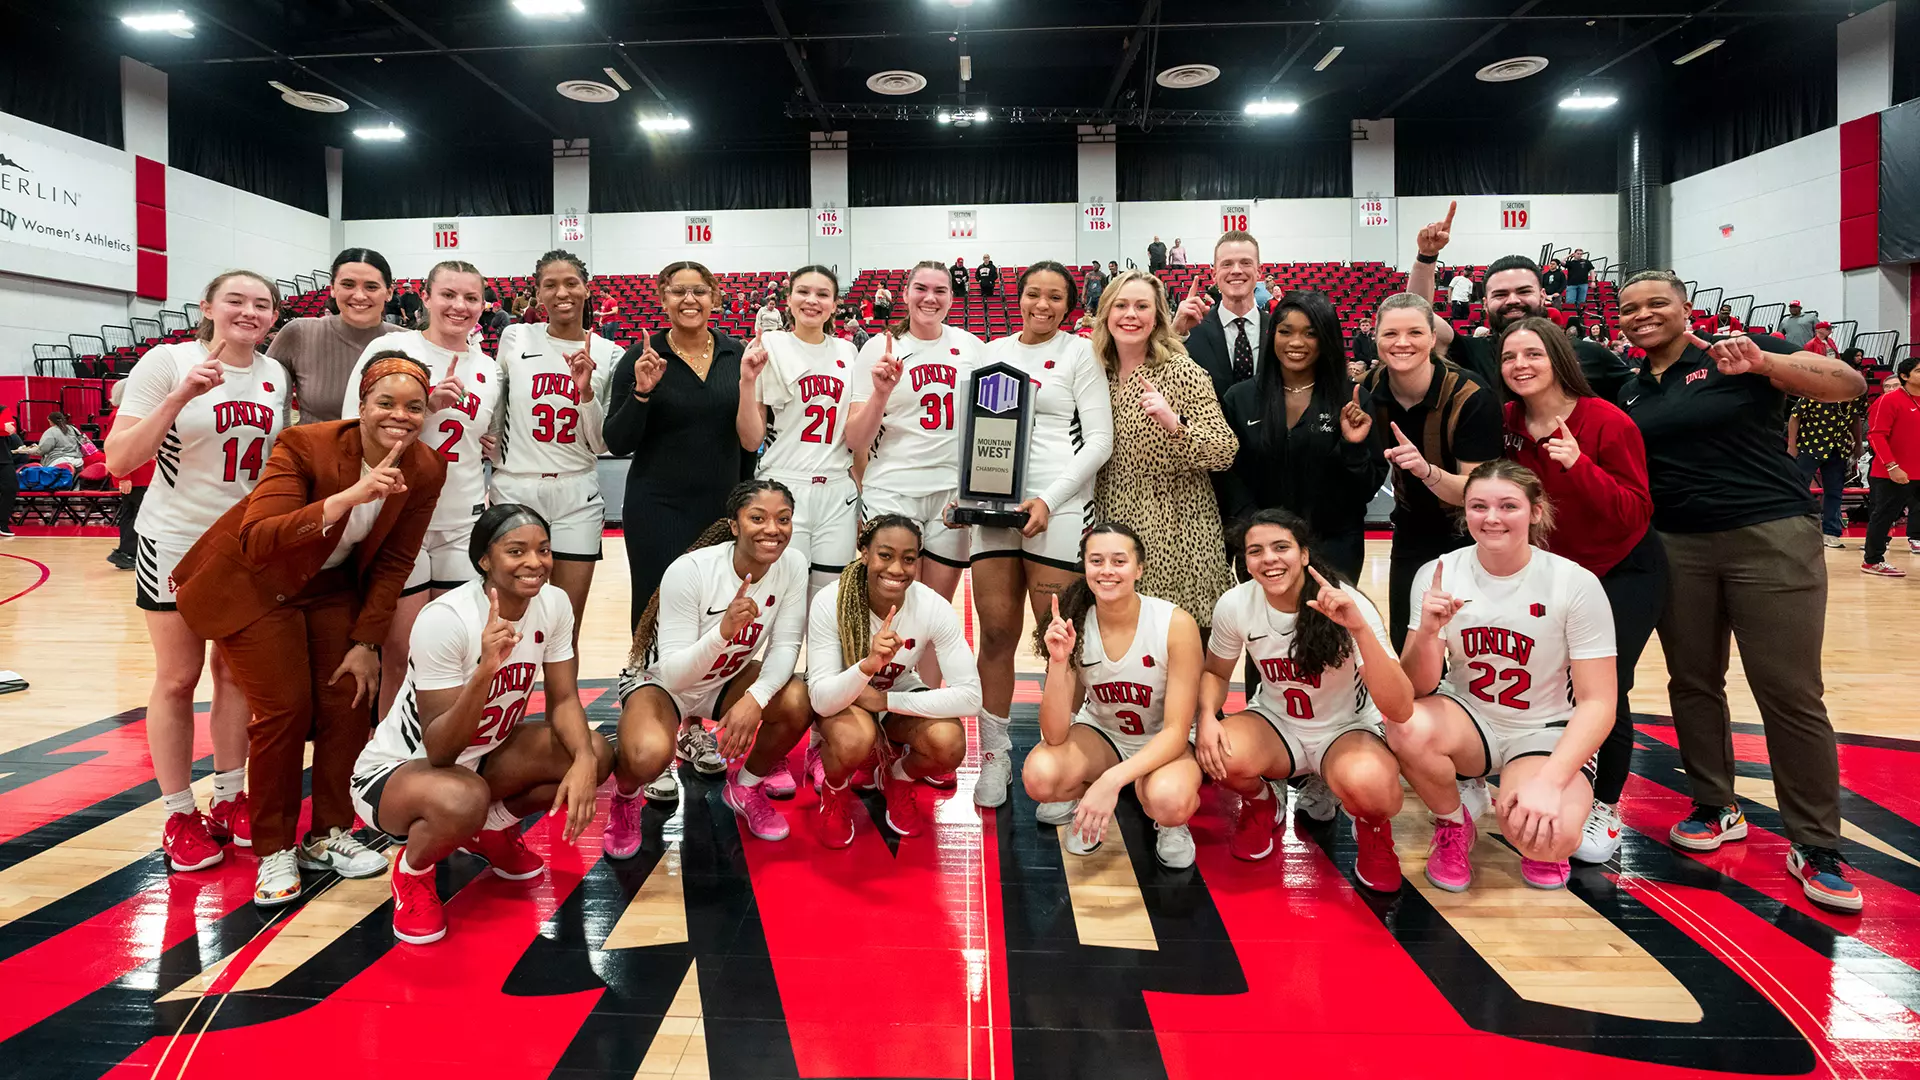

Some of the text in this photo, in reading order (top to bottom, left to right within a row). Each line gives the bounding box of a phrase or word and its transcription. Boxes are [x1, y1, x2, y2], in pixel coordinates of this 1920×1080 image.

[1090, 207, 1105, 216] 117
[1366, 202, 1382, 211] 118
[564, 218, 578, 227] 115
[822, 212, 837, 221] 116
[1090, 221, 1105, 230] 118
[1223, 214, 1247, 232] 118
[1367, 216, 1382, 225] 119
[1503, 210, 1528, 228] 119
[21, 217, 80, 242] Women's
[84, 232, 131, 252] Athletics
[564, 232, 578, 241] 116
[688, 225, 711, 242] 116
[822, 226, 837, 235] 117
[951, 220, 974, 237] 117
[435, 231, 458, 248] 115
[909, 364, 957, 392] UNLV
[1685, 367, 1708, 385] UNLV
[798, 375, 844, 403] UNLV
[213, 400, 274, 435] UNLV
[920, 392, 954, 430] 31
[532, 403, 579, 444] 32
[800, 405, 837, 444] 21
[437, 418, 464, 462] 2
[977, 438, 1012, 447] MOUNTAIN
[223, 437, 263, 482] 14
[977, 445, 1011, 459] WEST
[975, 465, 1009, 474] CHAMPIONS
[1461, 626, 1535, 666] UNLV
[1092, 681, 1153, 708] UNLV
[1468, 661, 1532, 710] 22
[1283, 688, 1314, 719] 0
[469, 697, 527, 747] 20
[1115, 710, 1145, 735] 3
